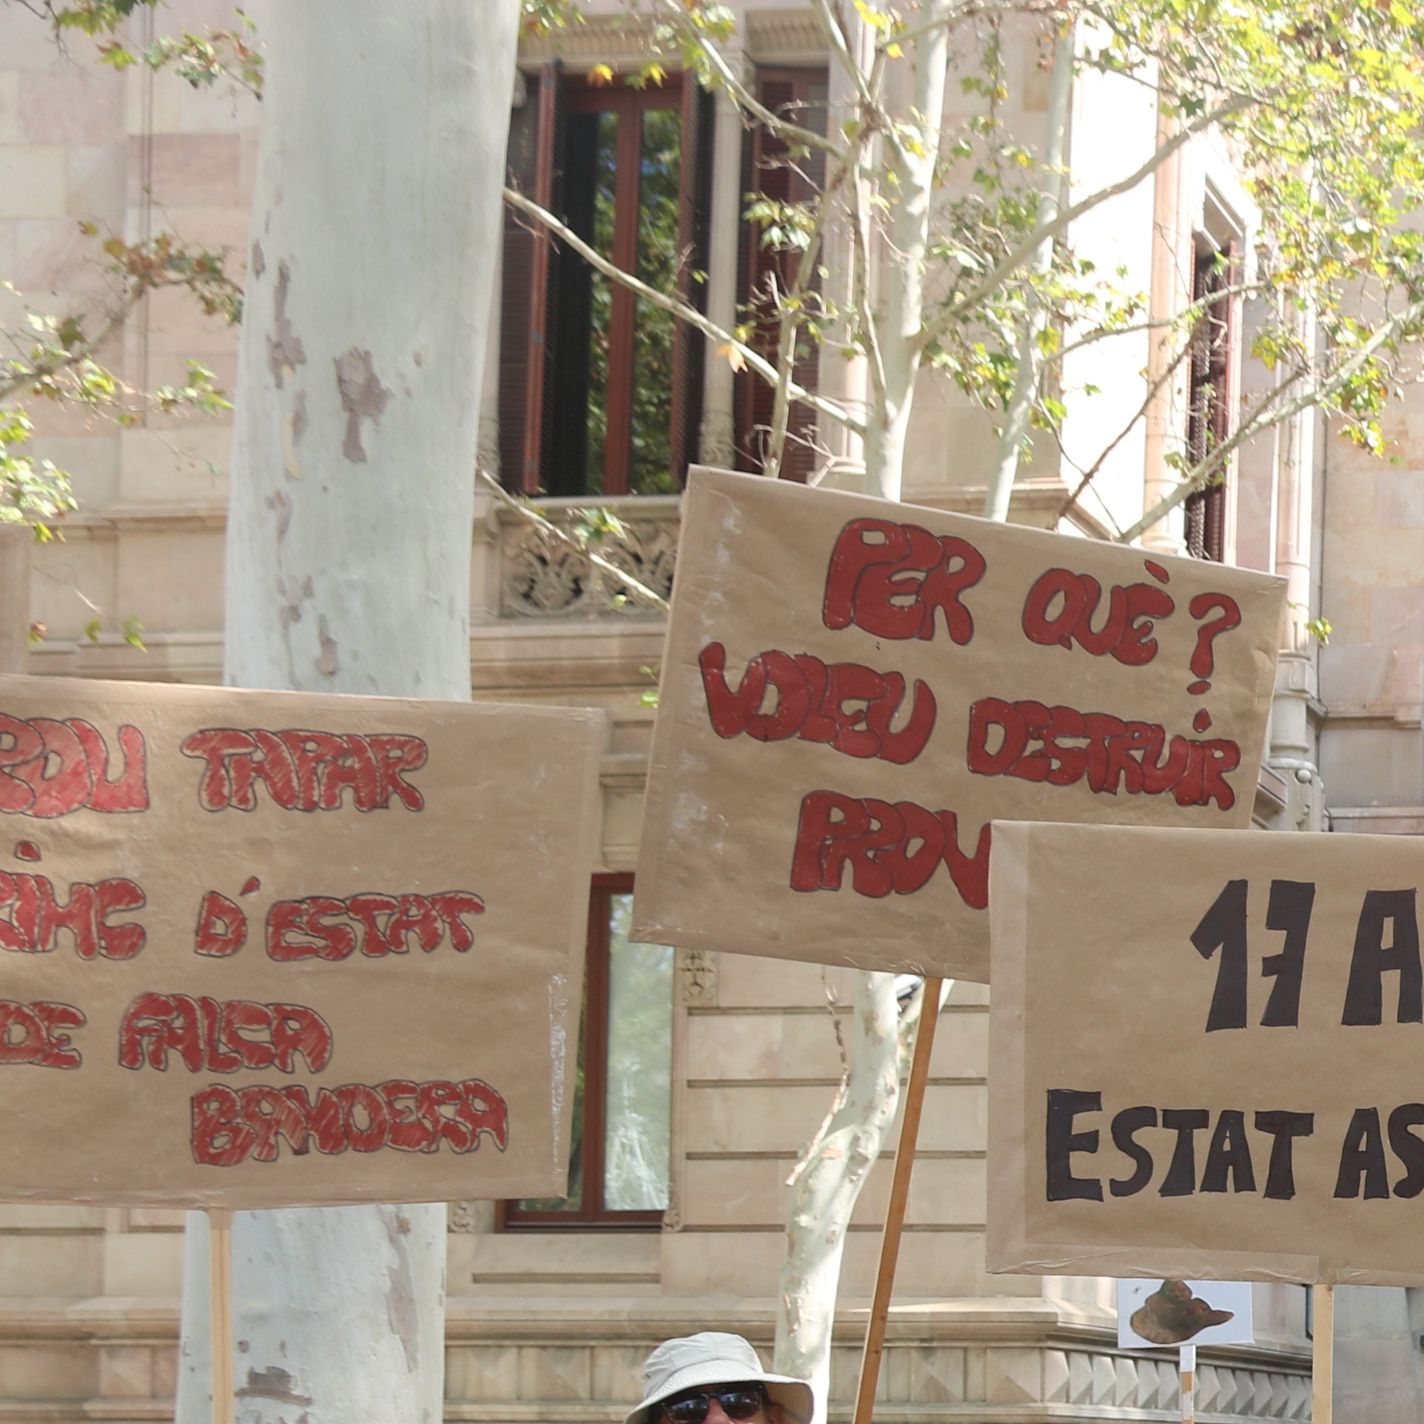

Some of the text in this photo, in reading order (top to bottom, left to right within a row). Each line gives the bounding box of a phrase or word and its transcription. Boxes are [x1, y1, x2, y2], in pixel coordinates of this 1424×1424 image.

[822, 517, 987, 646] PER
[181, 727, 428, 812] TAPAR
[699, 641, 1241, 811] VOLEU DESTRUIR
[1189, 879, 1424, 1032] 17 A
[191, 1078, 508, 1167] BANDERA
[1046, 1088, 1315, 1202] ESTAT
